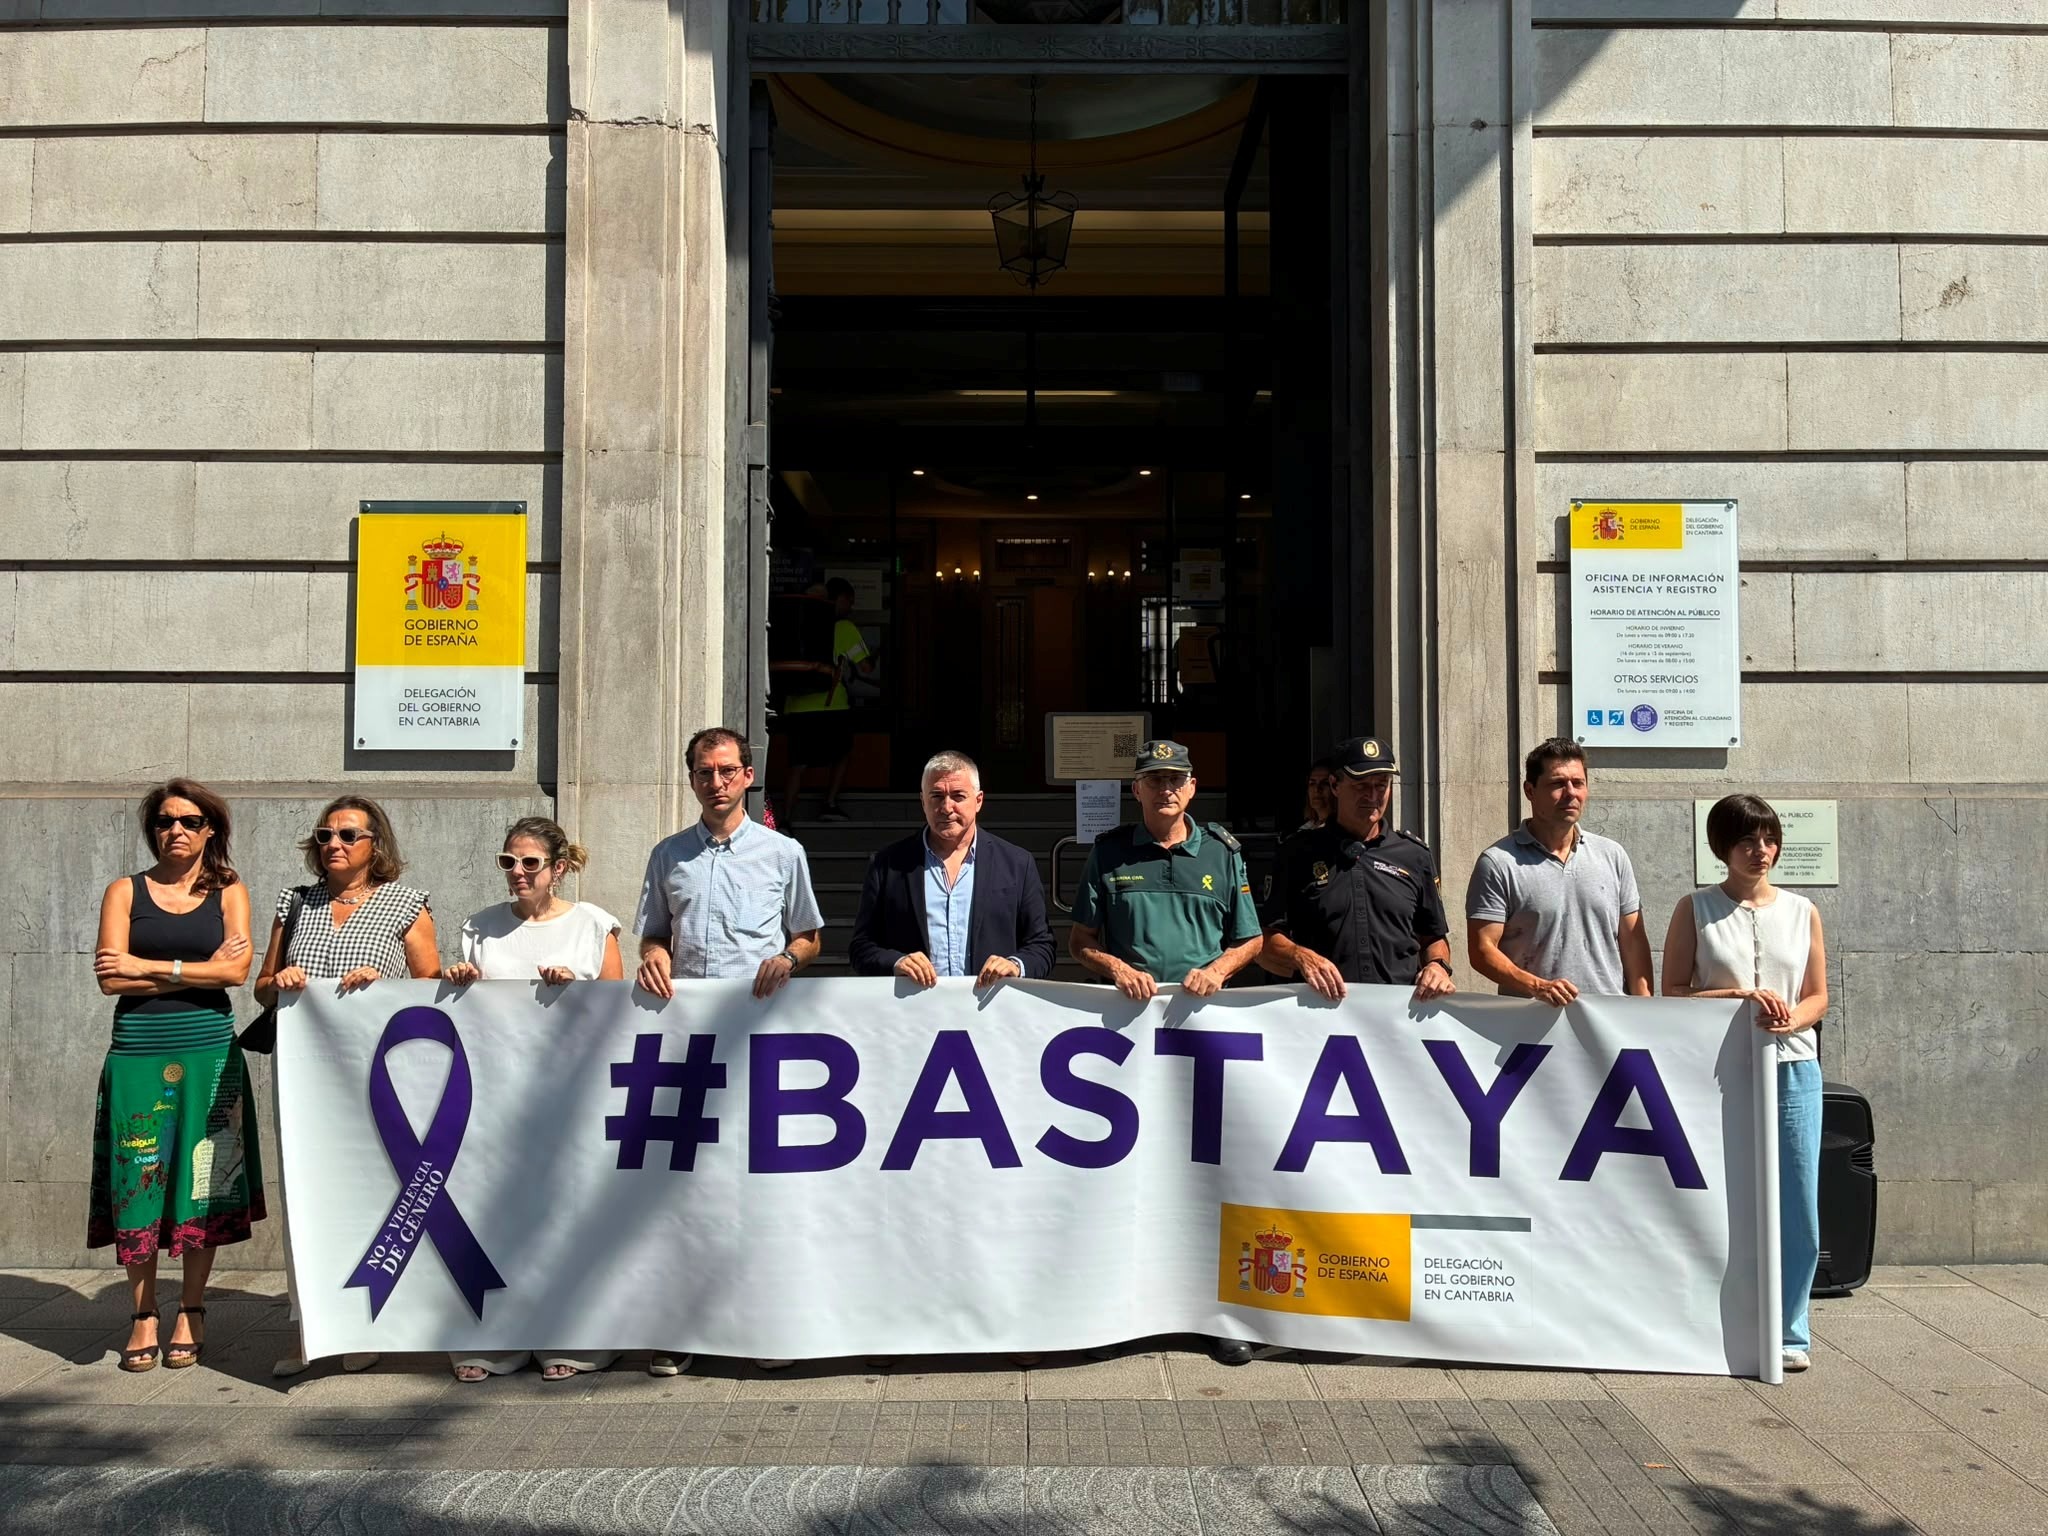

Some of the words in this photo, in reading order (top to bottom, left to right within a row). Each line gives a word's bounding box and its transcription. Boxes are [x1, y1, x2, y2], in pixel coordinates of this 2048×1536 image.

[1586, 574, 1629, 582] OFICINA
[1632, 574, 1646, 582] DE
[1650, 572, 1724, 582] INFORMACIÓN
[1593, 586, 1653, 594] ASISTENCIA
[1656, 586, 1663, 594] Y
[1667, 586, 1717, 594] REGISTRO
[1637, 608, 1678, 616] ATENCIÓN
[1688, 608, 1720, 617] PÚBLICO
[404, 619, 479, 631] GOBIERNO
[404, 635, 422, 646] DE
[426, 632, 478, 646] ESPAÑA
[1614, 675, 1648, 684] OTROS
[1650, 675, 1699, 684] SERVICIOS
[404, 686, 476, 698] DELEGACIÓN
[399, 703, 419, 712] DEL
[422, 702, 481, 713] GOBIERNO
[399, 716, 414, 726] EN
[417, 716, 480, 727] CANTABRIA
[605, 1026, 1708, 1190] #BASTAYA
[388, 1160, 433, 1231] VIOLENCIA
[381, 1244, 406, 1277] DE
[400, 1170, 443, 1243] GENERO
[385, 1233, 393, 1243] +
[366, 1245, 386, 1271] NO
[1318, 1254, 1390, 1269] GOBIERNO
[1424, 1257, 1503, 1271] DELEGACIÓN
[1318, 1268, 1336, 1279] DE
[1339, 1267, 1389, 1283] ESPAÑA
[1424, 1274, 1447, 1286] DEL
[1450, 1274, 1516, 1287] GOBIERNO
[1424, 1289, 1441, 1301] EN
[1444, 1289, 1515, 1303] CANTABRIA
